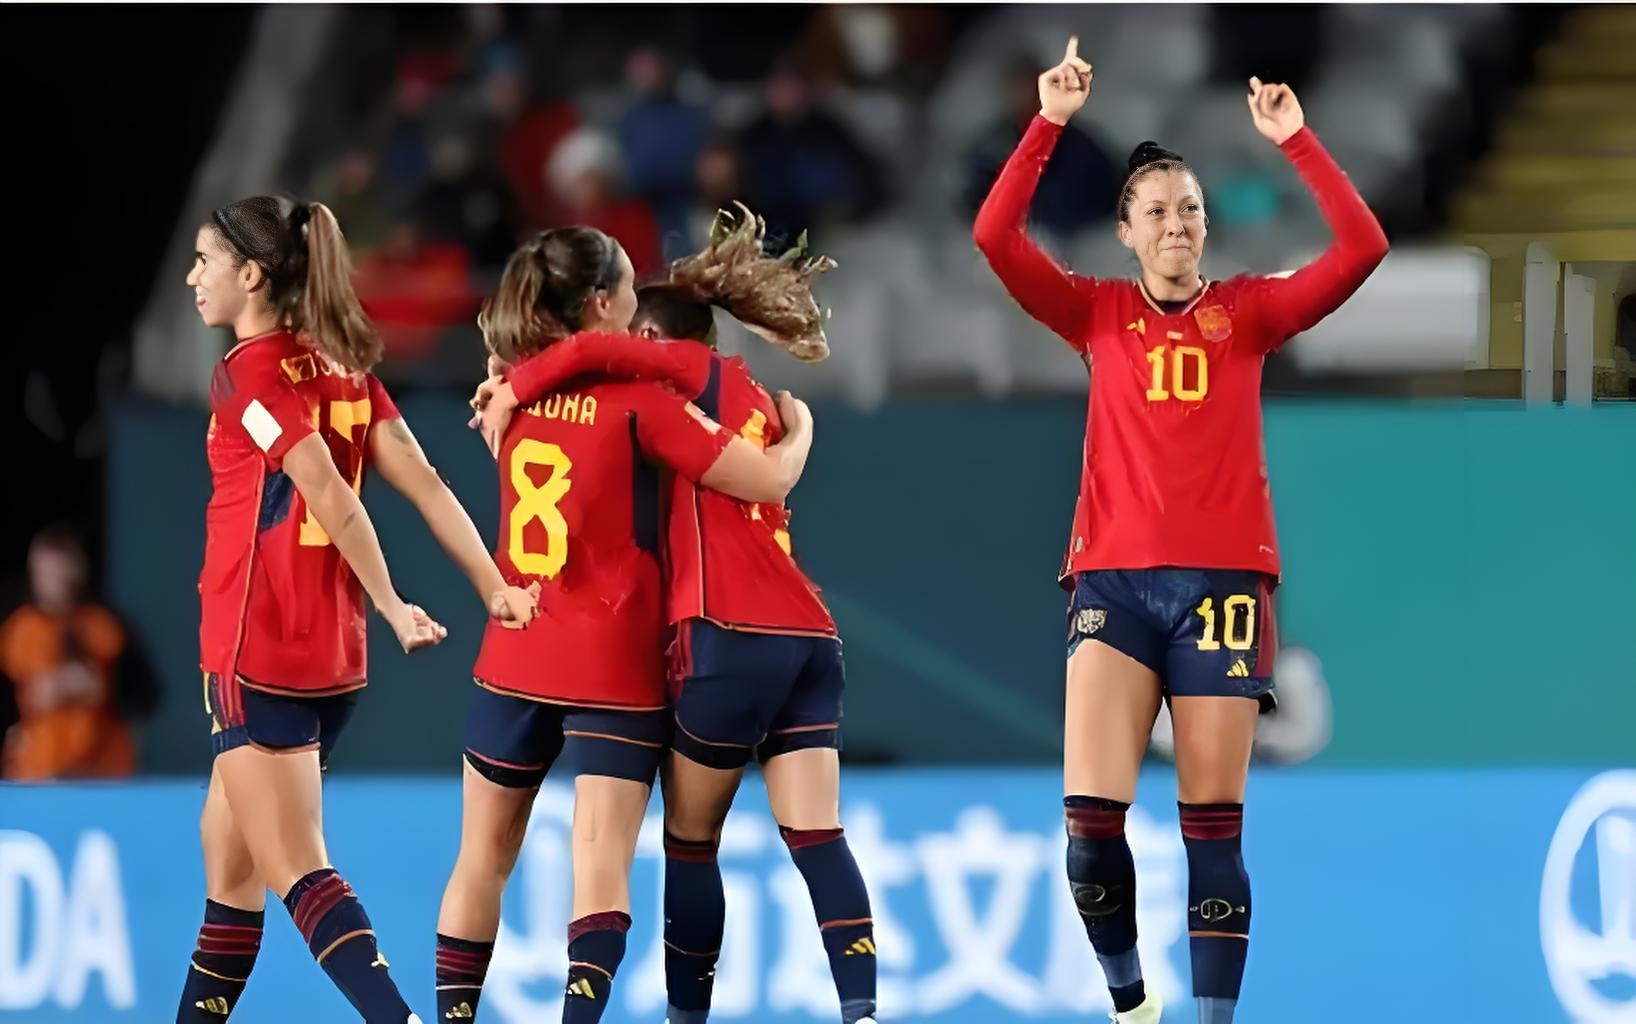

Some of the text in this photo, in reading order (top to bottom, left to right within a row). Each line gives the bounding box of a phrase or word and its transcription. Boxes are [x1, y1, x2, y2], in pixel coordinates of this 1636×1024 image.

[1146, 345, 1208, 402] 10
[509, 437, 572, 580] 8
[1196, 594, 1256, 650] 10
[0, 829, 137, 1011] DA
